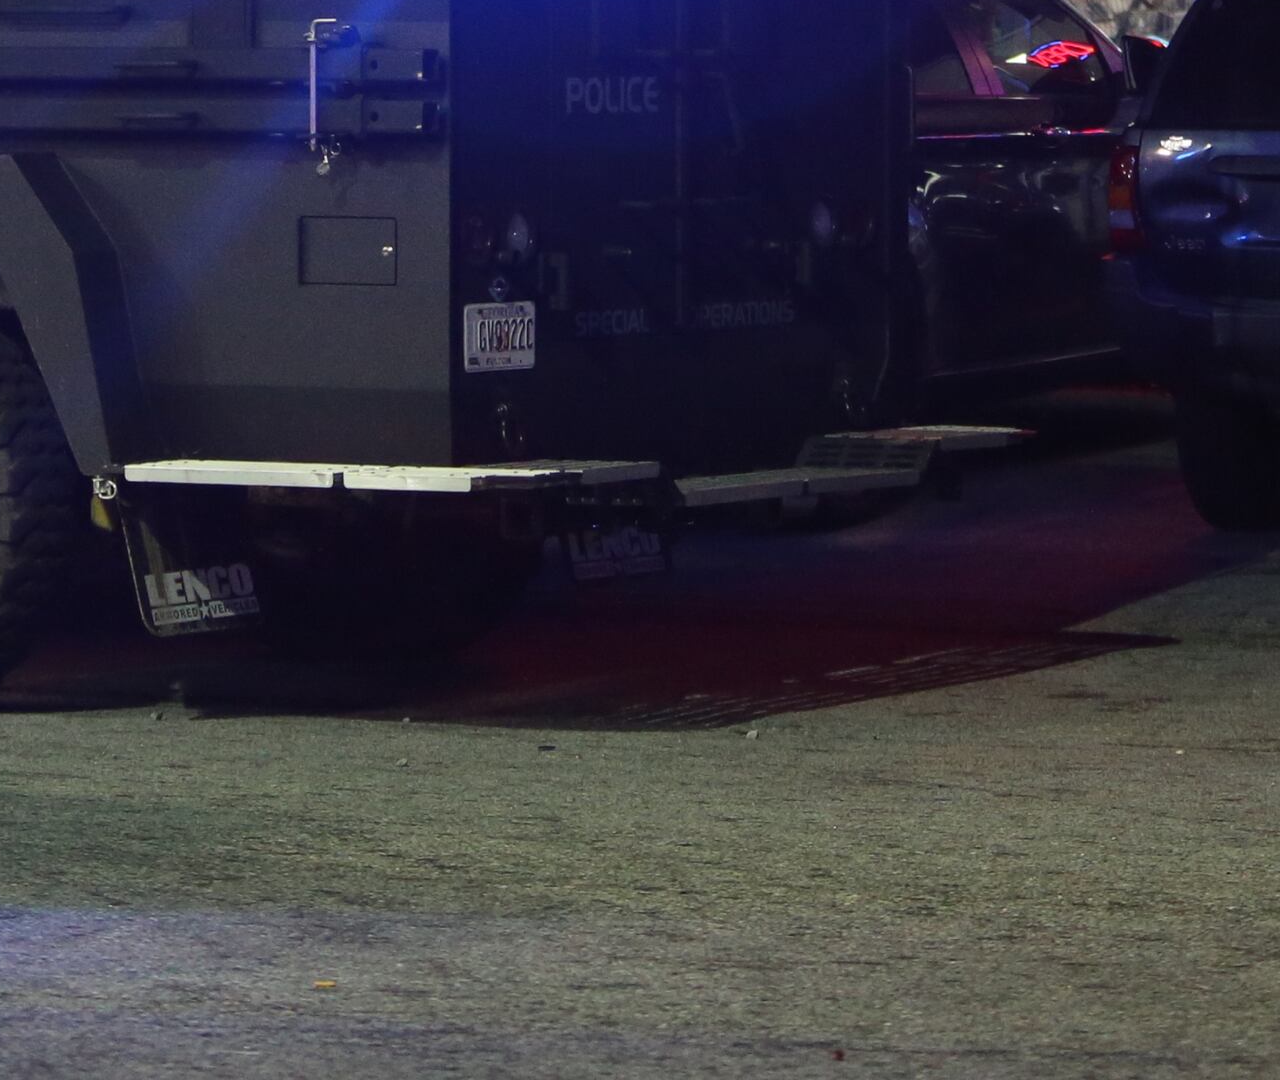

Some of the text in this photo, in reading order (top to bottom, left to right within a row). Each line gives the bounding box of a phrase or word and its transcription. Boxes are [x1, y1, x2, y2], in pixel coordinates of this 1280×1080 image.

[566, 76, 659, 114] POLICE
[575, 308, 651, 337] SPECIAL
[144, 562, 255, 608] LENCO
